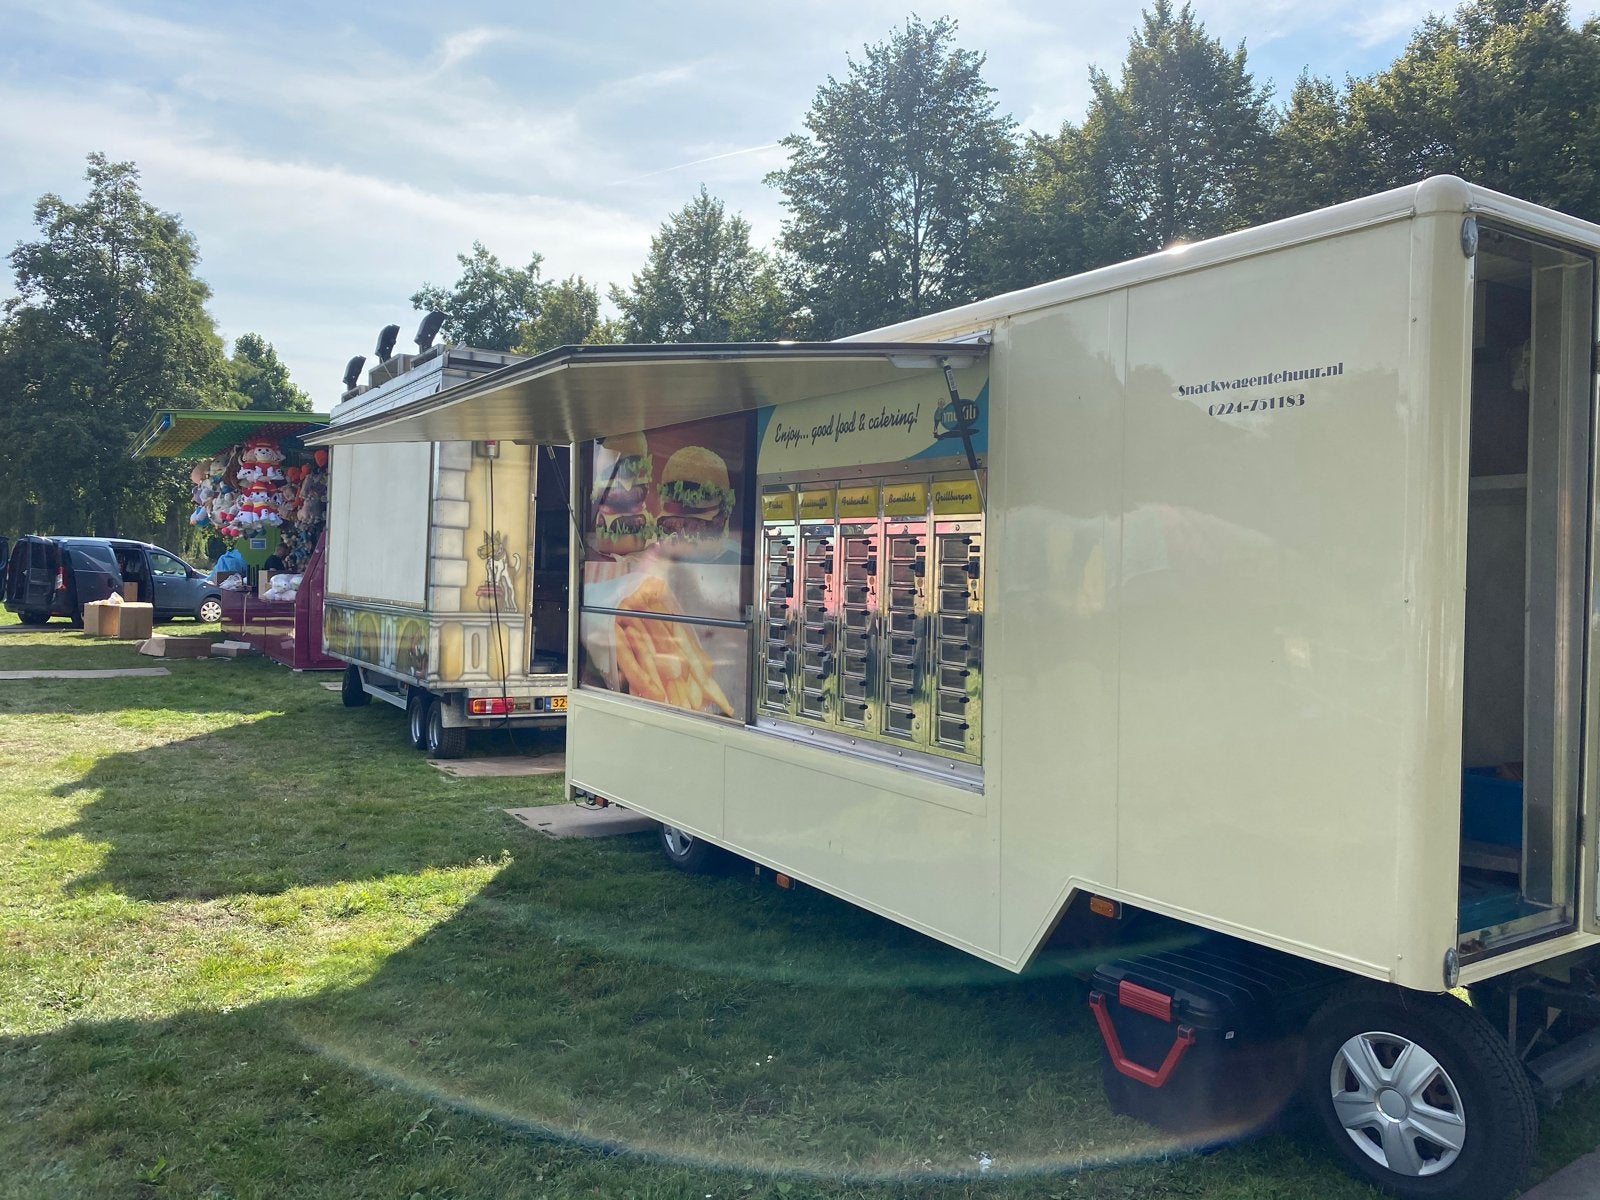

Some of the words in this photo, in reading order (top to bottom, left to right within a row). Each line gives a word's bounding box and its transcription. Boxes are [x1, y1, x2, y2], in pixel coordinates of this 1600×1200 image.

[1178, 362, 1344, 396] Snackwagentehuur.nl
[1208, 393, 1305, 417] 0224-751183
[774, 423, 809, 448] Enjoy...
[811, 414, 834, 445] good
[834, 410, 857, 442] food
[858, 413, 867, 431] &
[868, 403, 920, 433] catering!
[935, 489, 973, 504] Grillburger
